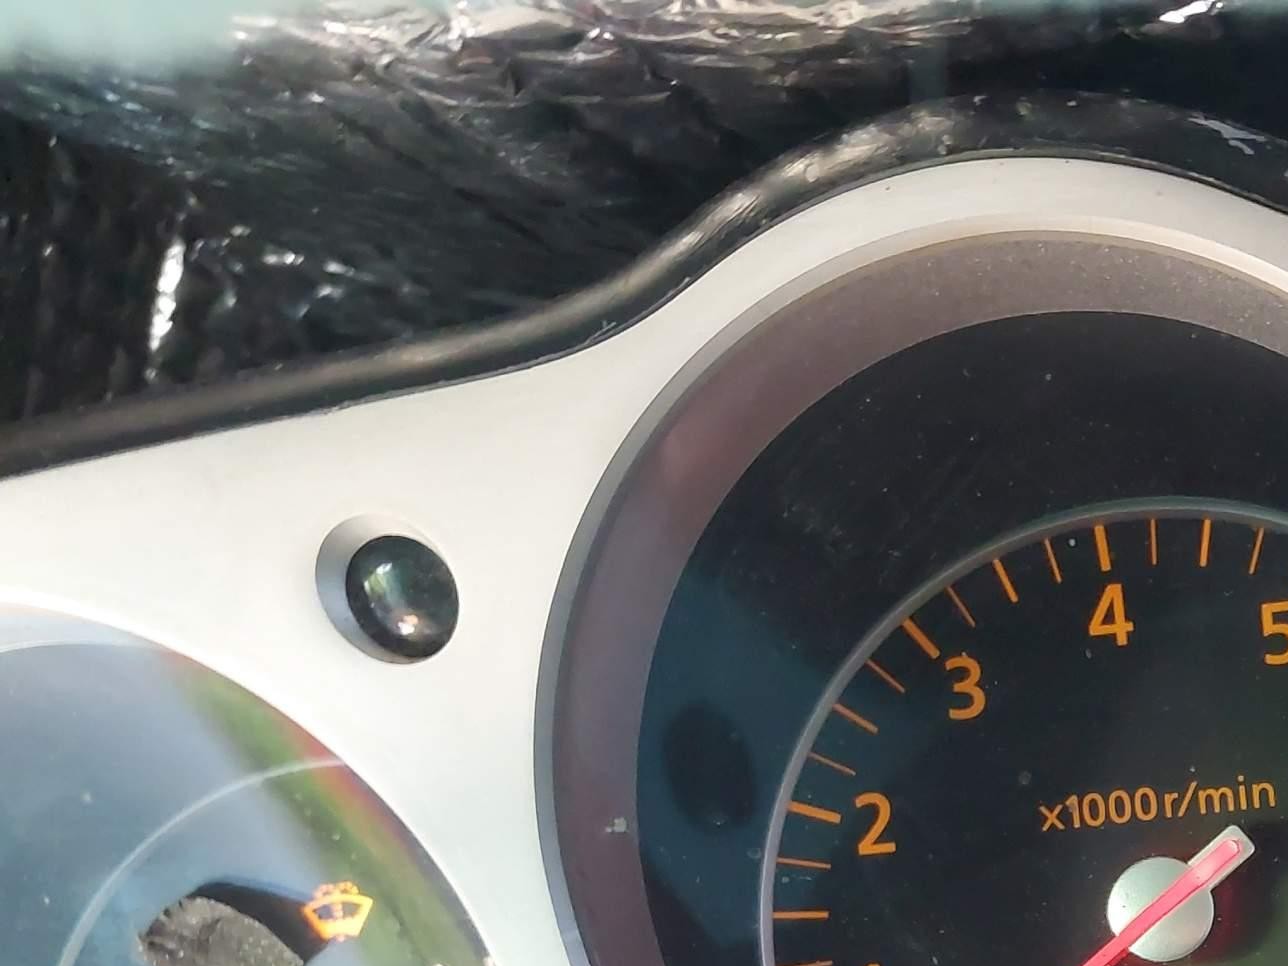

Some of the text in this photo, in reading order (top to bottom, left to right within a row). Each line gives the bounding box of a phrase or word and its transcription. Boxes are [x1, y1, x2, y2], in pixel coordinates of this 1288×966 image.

[1088, 583, 1135, 646] 4
[944, 655, 986, 720] 3
[854, 792, 897, 856] 2
[1039, 775, 1276, 832] x1000 r/min
